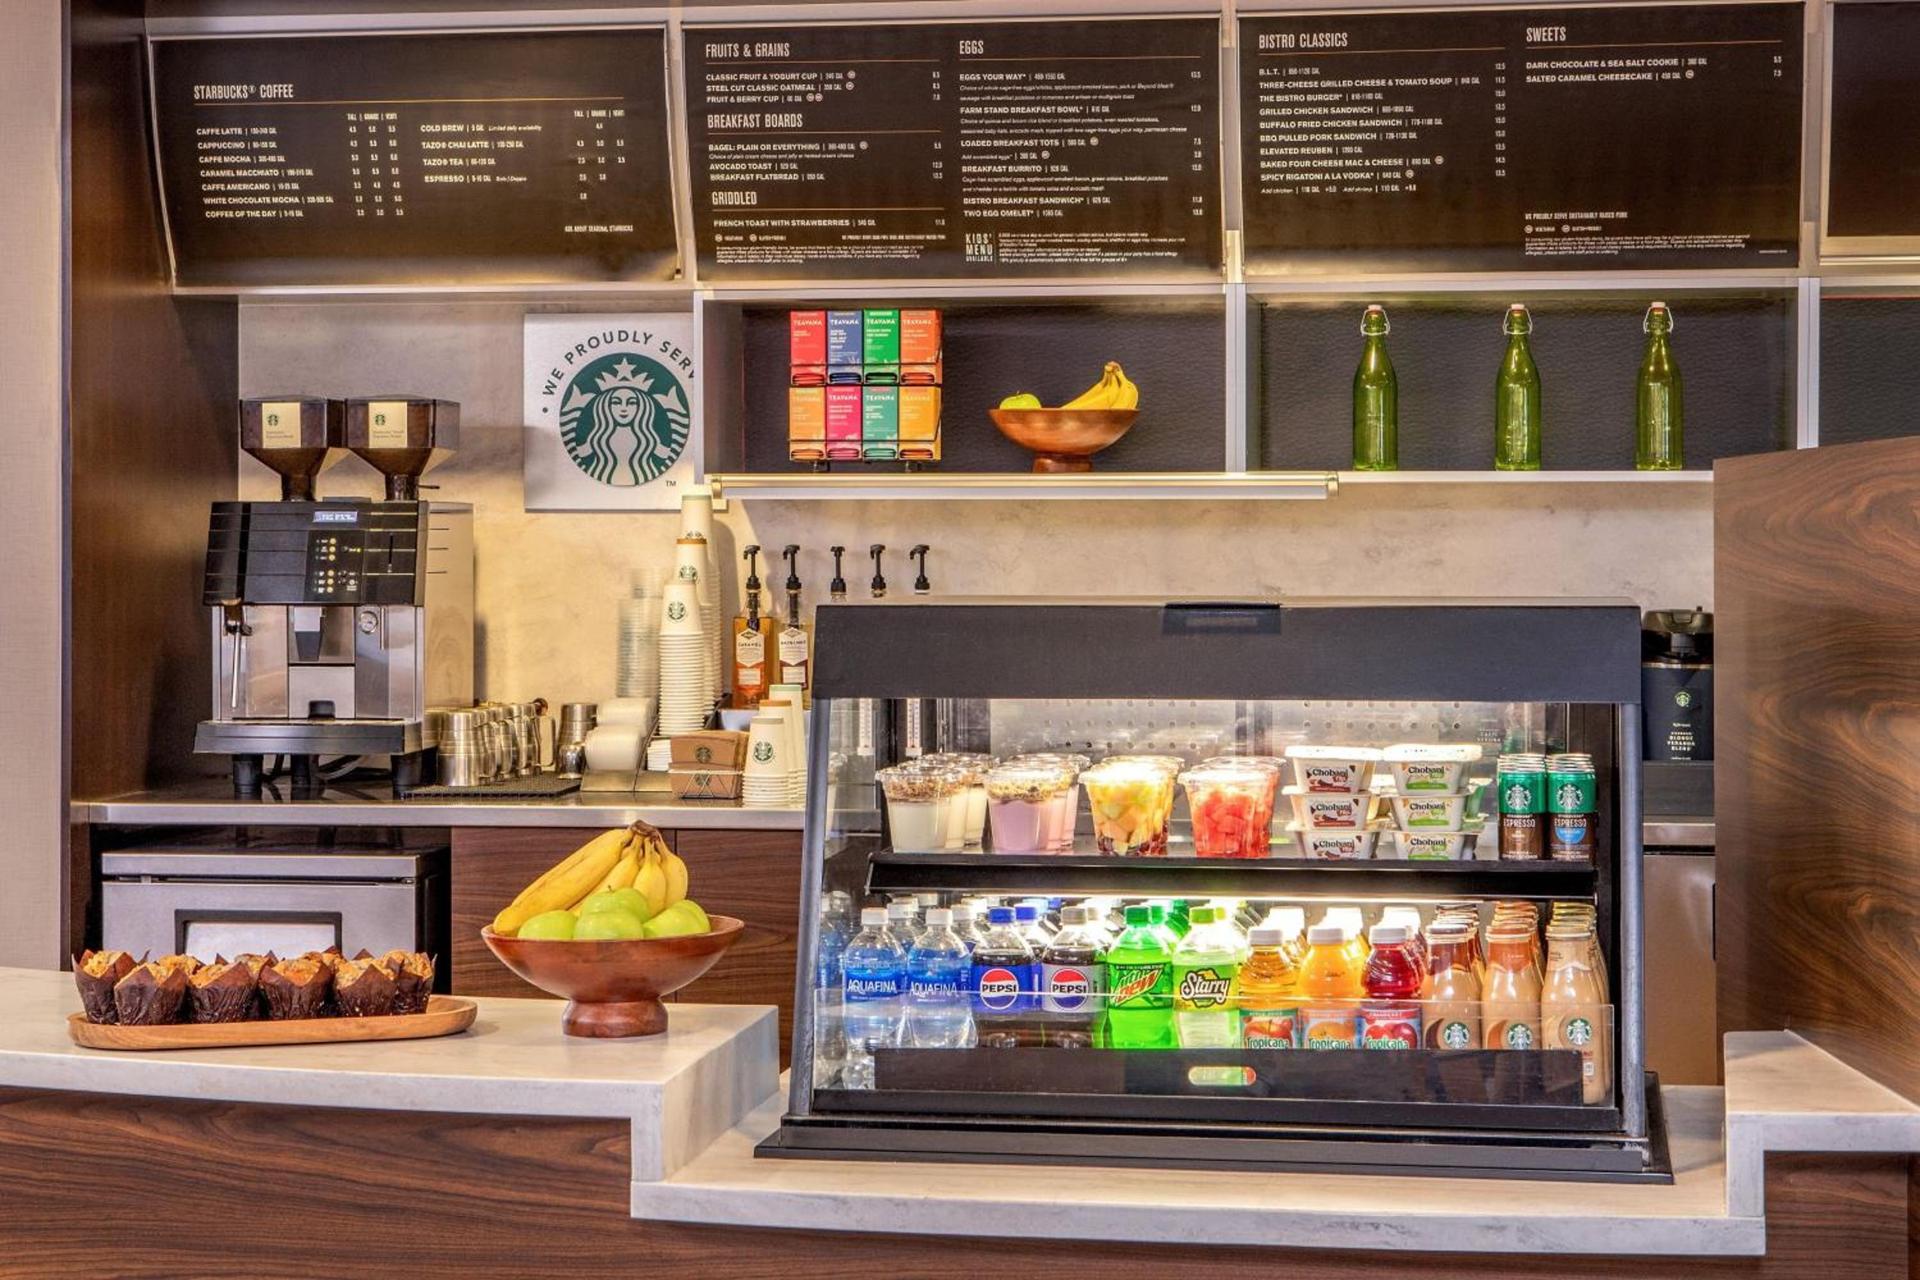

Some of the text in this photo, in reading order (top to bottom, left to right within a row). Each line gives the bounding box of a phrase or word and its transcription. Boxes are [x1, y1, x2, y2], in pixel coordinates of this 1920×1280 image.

[1527, 27, 1566, 41] SWEETS
[1259, 33, 1347, 48] BISTRO CLASSICS
[706, 43, 789, 57] FRUITS & GRAINS
[960, 41, 983, 54] EGGS
[260, 84, 293, 98] COFFEE
[708, 114, 803, 128] BREAKFAST BOARDS
[712, 192, 757, 205] GRIDDLED
[966, 245, 992, 255] MENU
[543, 368, 564, 397] WE
[565, 330, 653, 364] PROUDLY
[1312, 768, 1348, 778] Chobani
[1408, 766, 1444, 774] Chobani
[1316, 803, 1352, 813] Chobani
[1410, 802, 1445, 810] Chobani
[1504, 819, 1535, 827] ESPRESSO
[1554, 818, 1586, 827] ESPRESSO
[1320, 840, 1354, 850] Chobani
[1410, 838, 1446, 846] Chobani
[847, 979, 897, 995] AQUAFINA
[910, 982, 958, 998] AQUAFINA
[982, 984, 1016, 993] PEPSI
[1052, 984, 1087, 994] PEPSI
[1181, 972, 1230, 1003] Starry
[1247, 1037, 1289, 1049] Tropicana
[1308, 1038, 1350, 1050] Tropicana
[1366, 1037, 1408, 1049] Tropicana
